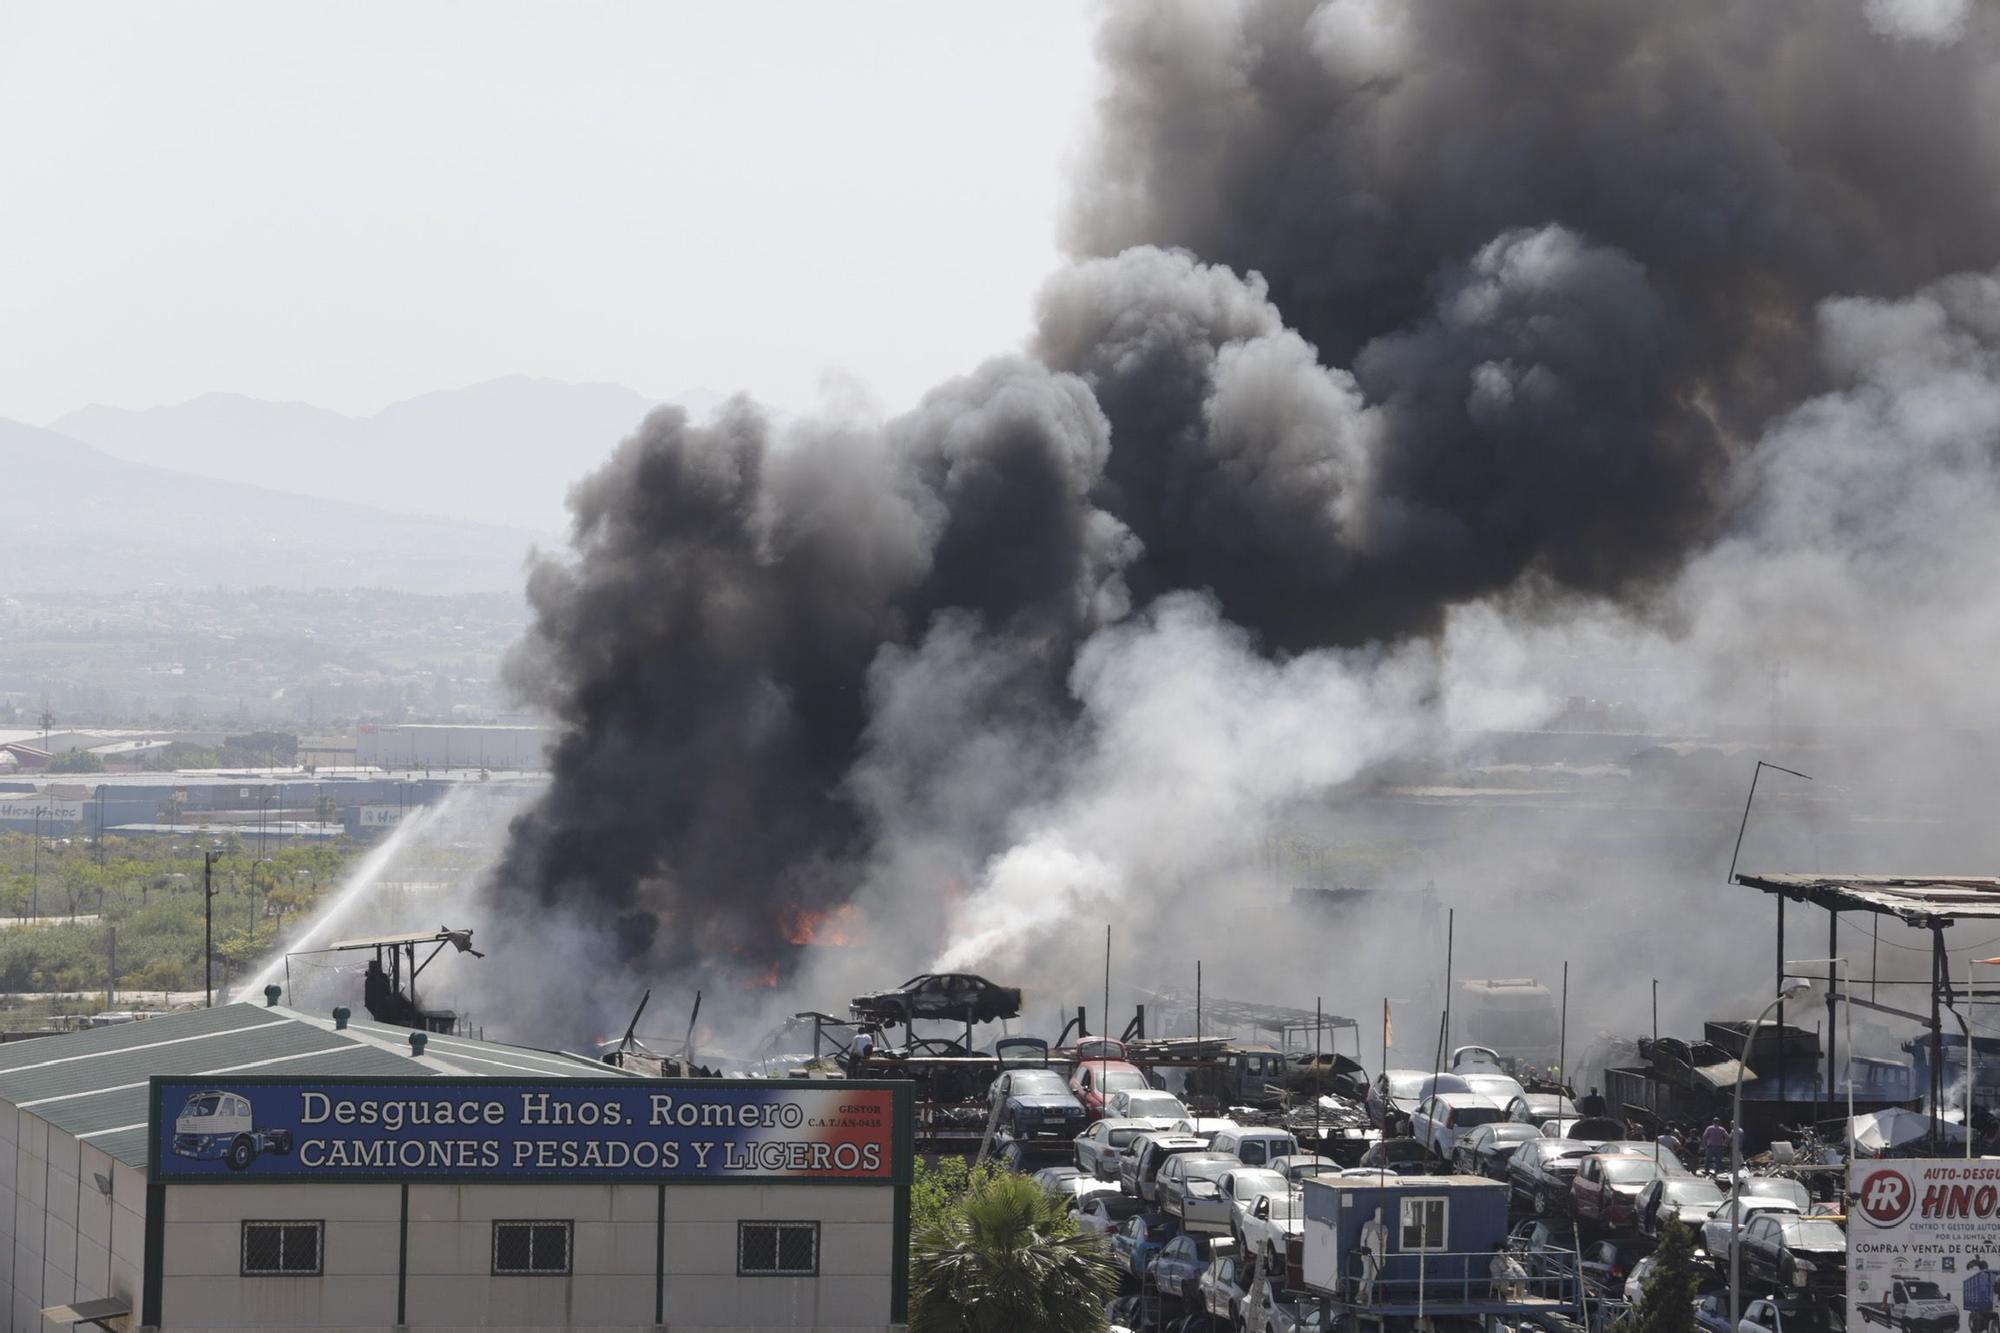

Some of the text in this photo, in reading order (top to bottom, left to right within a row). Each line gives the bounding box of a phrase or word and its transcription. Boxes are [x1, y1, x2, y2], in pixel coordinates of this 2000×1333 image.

[300, 1092, 803, 1132] Desguace Hnos. Romero
[839, 1105, 881, 1114] GESTOR
[300, 1140, 882, 1171] CAMIONES PESADOS Y LIGEROS
[1867, 1177, 1903, 1211] HR
[1921, 1184, 2000, 1219] HNO
[1909, 1223, 1939, 1231] CENTRO
[1941, 1223, 1946, 1231] Y
[1947, 1223, 1975, 1231] GESTOR
[1856, 1243, 1900, 1253] COMPRA
[1902, 1244, 1909, 1253] Y
[1912, 1244, 1945, 1254] VENTA
[1948, 1244, 1962, 1254] DE
